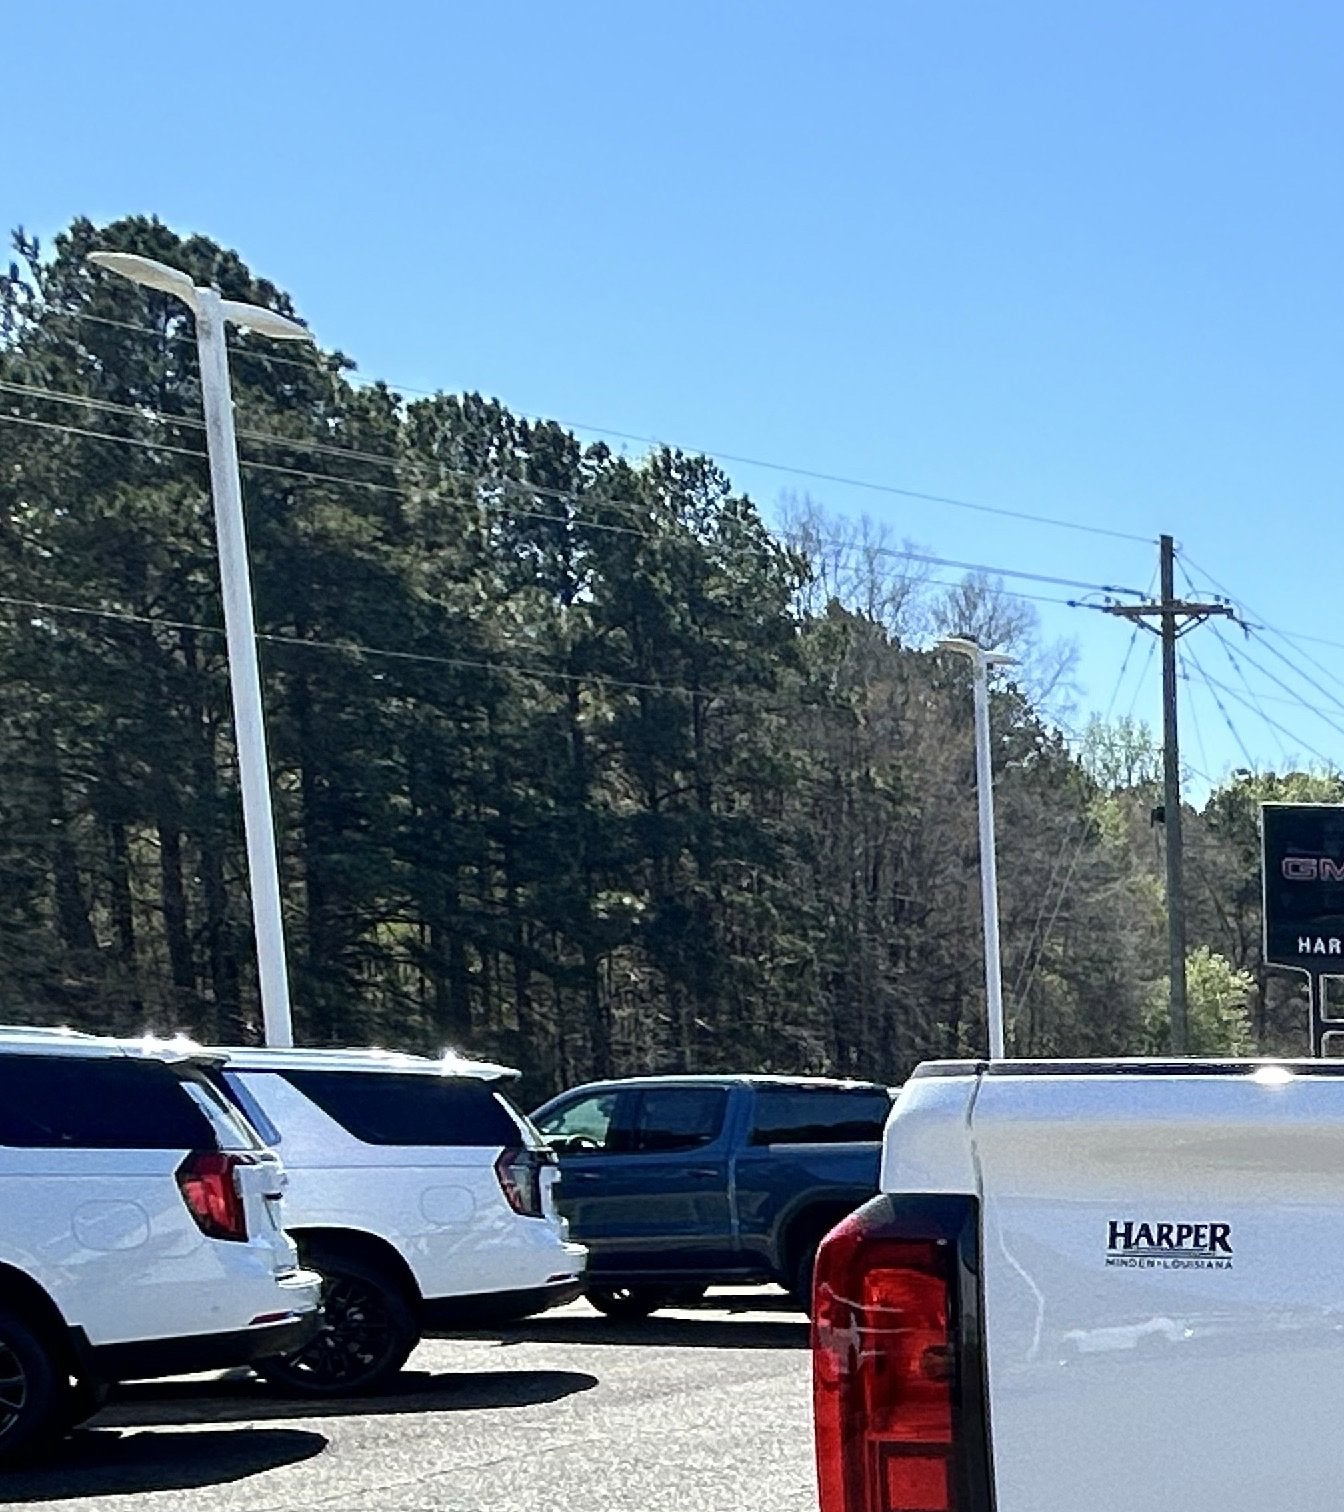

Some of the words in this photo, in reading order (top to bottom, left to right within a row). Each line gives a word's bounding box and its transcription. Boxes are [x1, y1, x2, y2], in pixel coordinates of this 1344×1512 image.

[1108, 1220, 1233, 1253] HARPER
[1105, 1258, 1155, 1269] MINDEN
[1163, 1258, 1233, 1270] LOUISIANA
